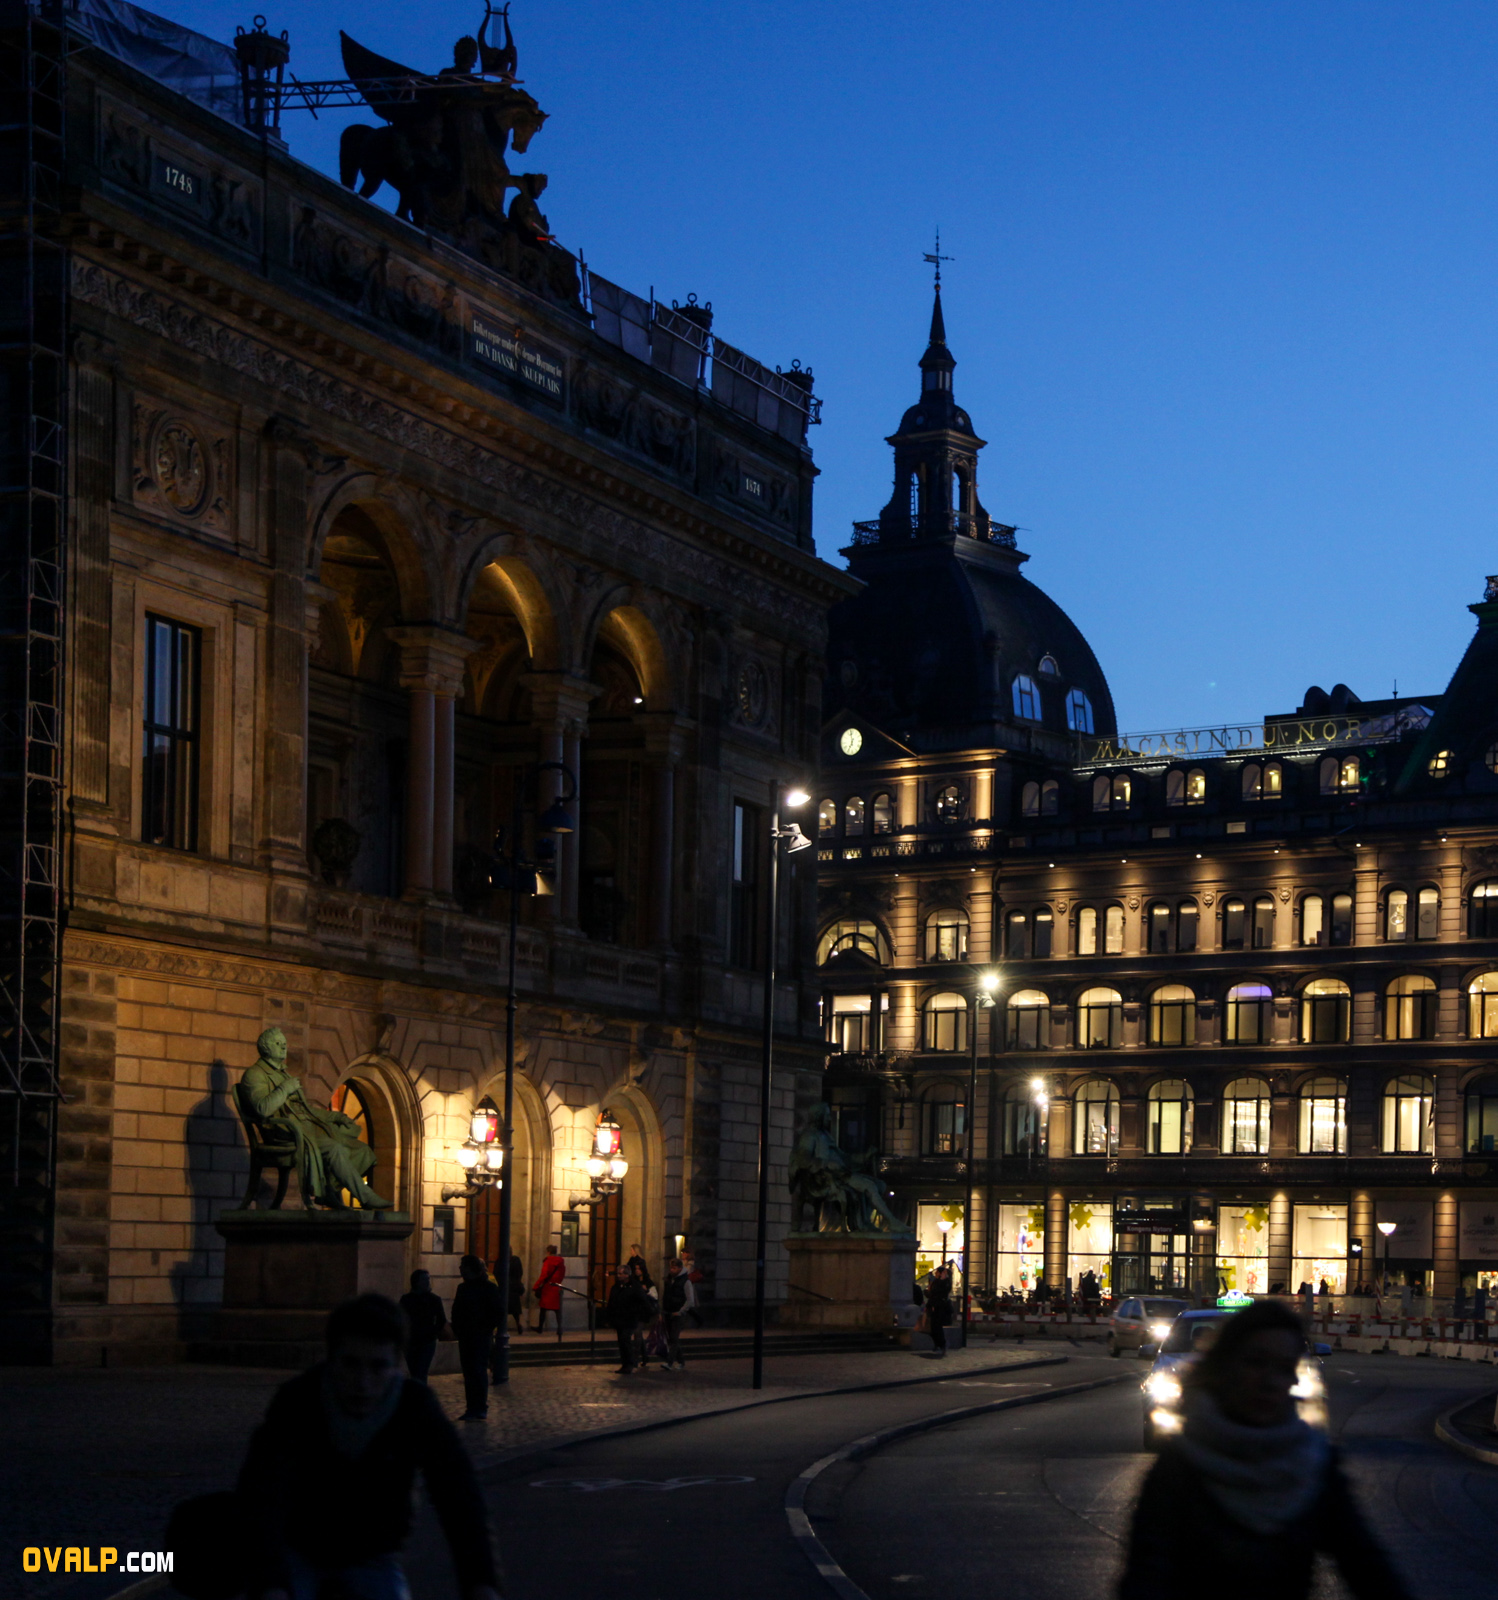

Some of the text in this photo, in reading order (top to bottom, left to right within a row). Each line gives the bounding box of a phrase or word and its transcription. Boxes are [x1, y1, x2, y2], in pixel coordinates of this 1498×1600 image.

[165, 166, 193, 195] 1748
[475, 339, 490, 359] DEN
[1237, 725, 1276, 749] DU
